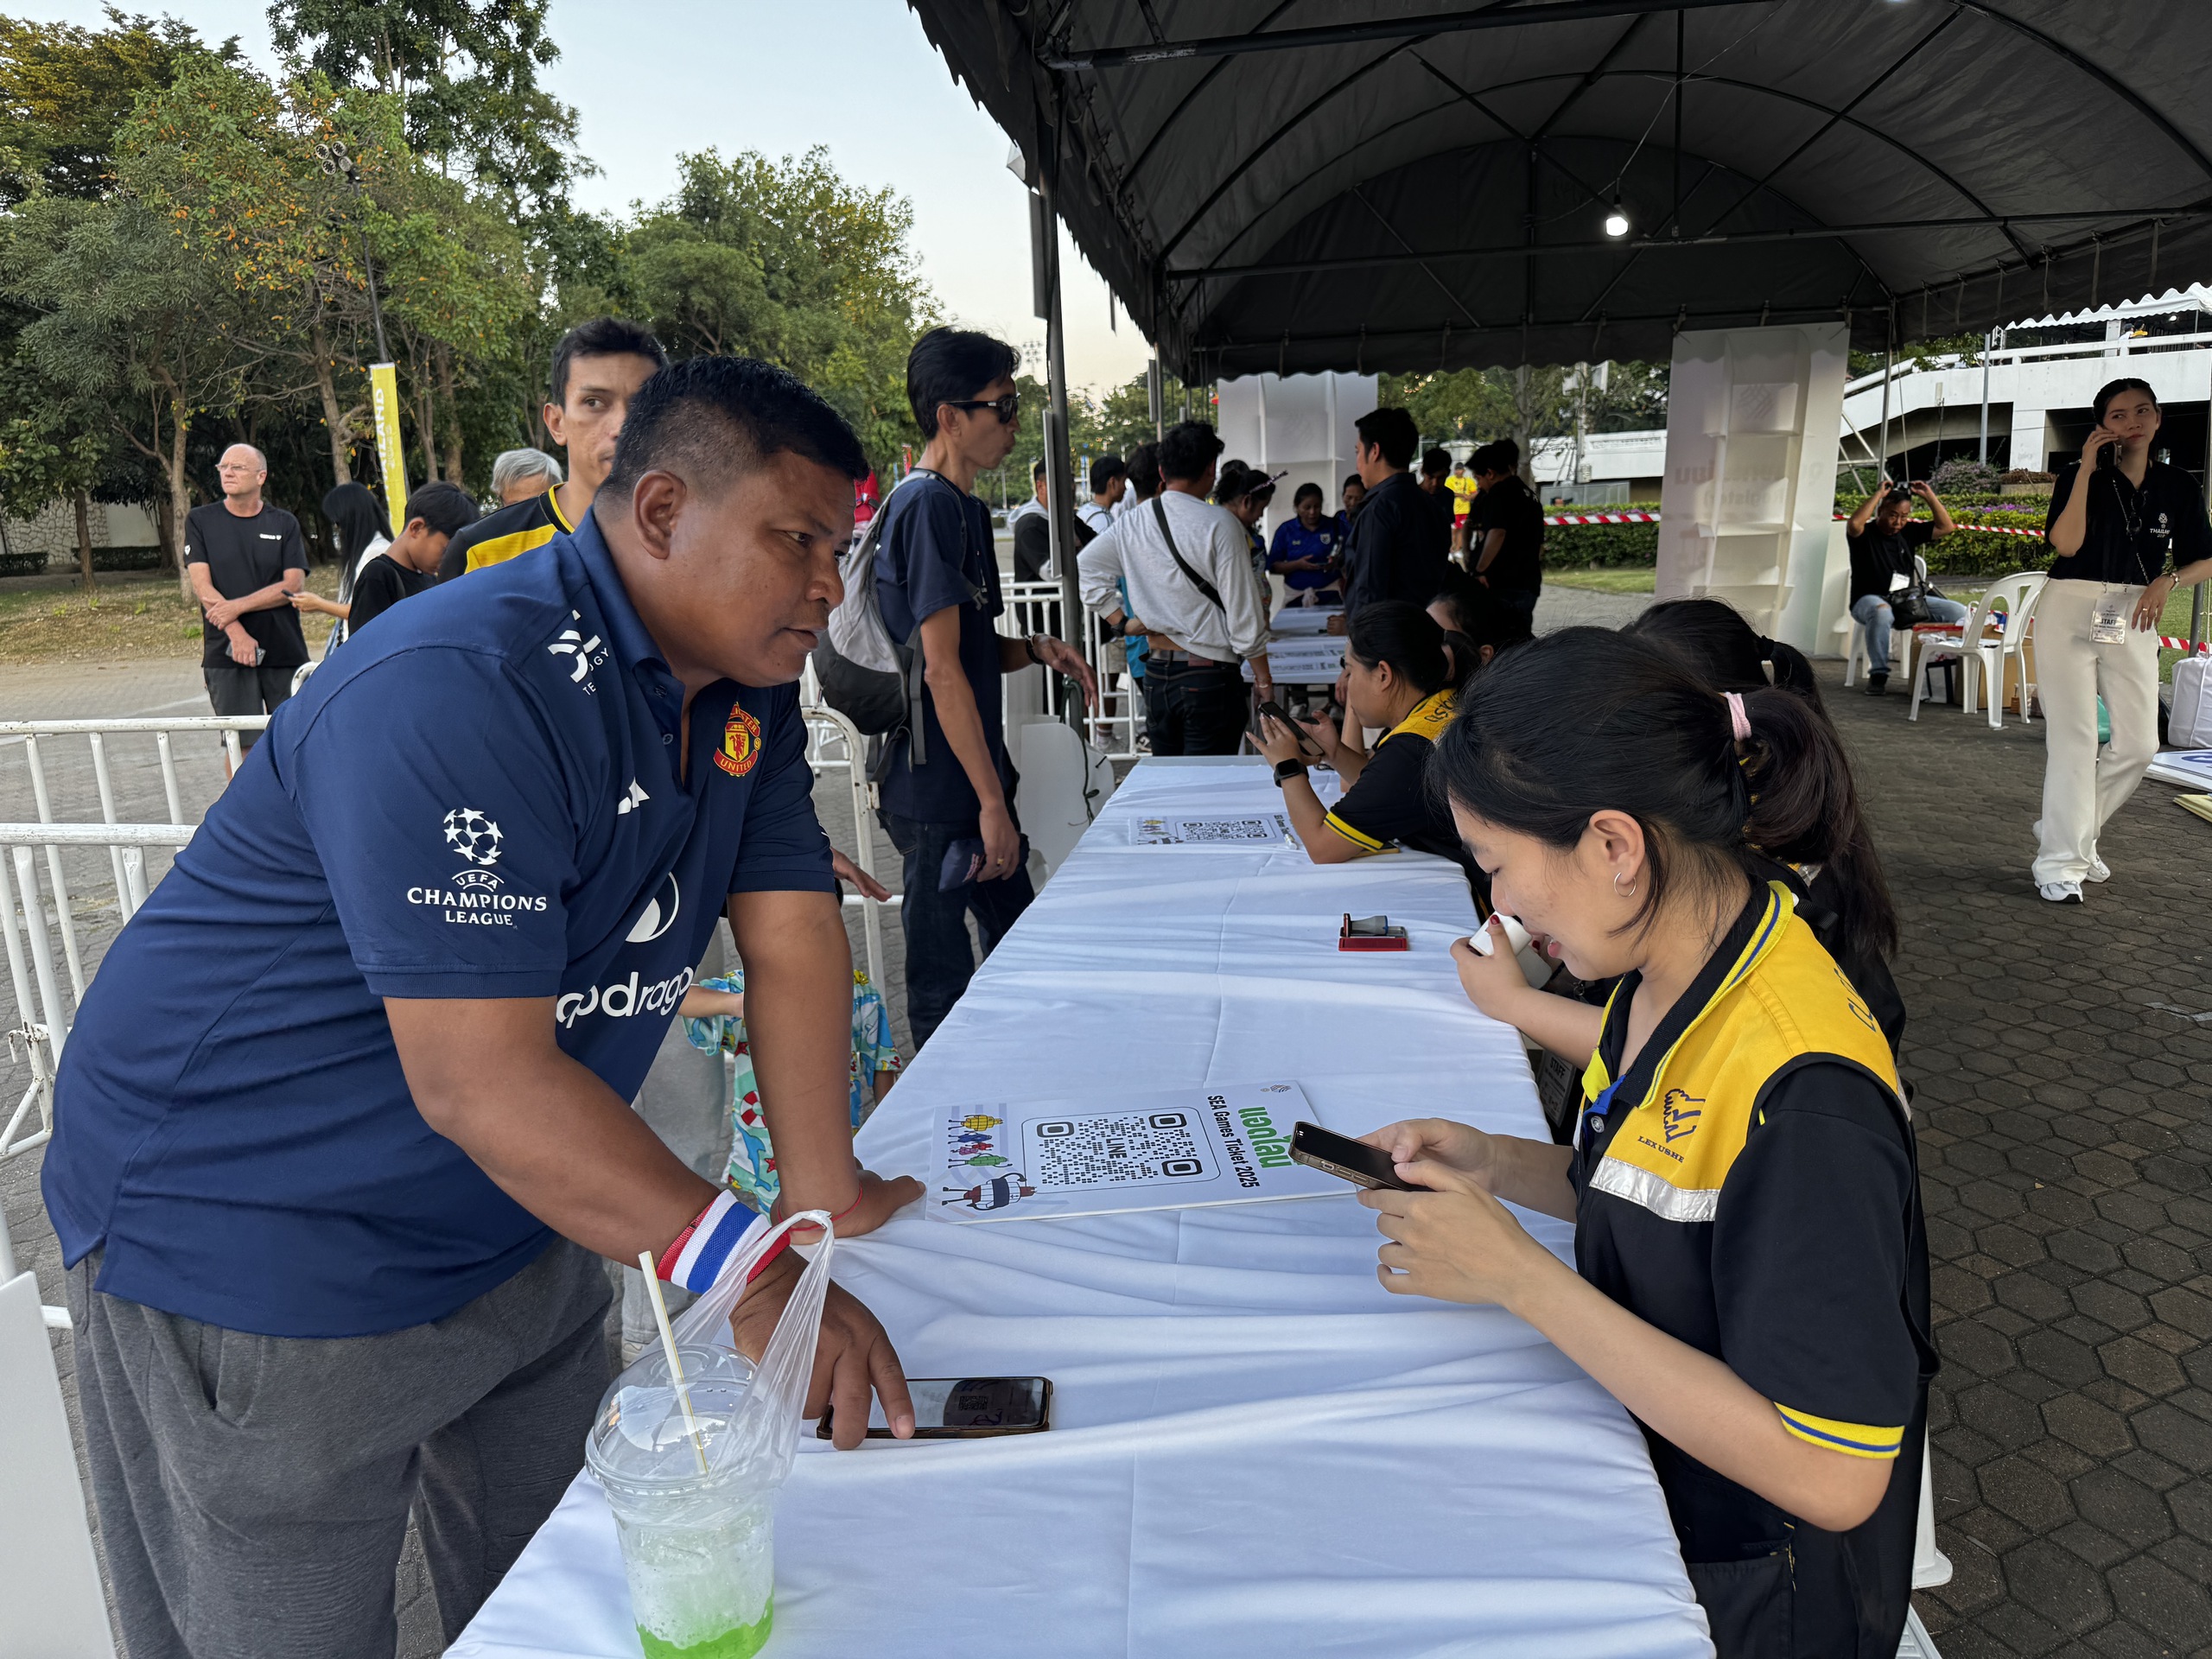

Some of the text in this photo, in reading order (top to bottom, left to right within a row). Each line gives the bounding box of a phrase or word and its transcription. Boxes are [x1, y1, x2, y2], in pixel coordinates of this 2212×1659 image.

[720, 758, 752, 772] UNITED
[456, 874, 499, 889] UEFA
[407, 887, 548, 912] CHAMPIONS
[445, 910, 513, 925] LEAGUE
[1106, 1137, 1128, 1159] LINE
[1207, 1095, 1261, 1188] SEA Games Ticket 2025
